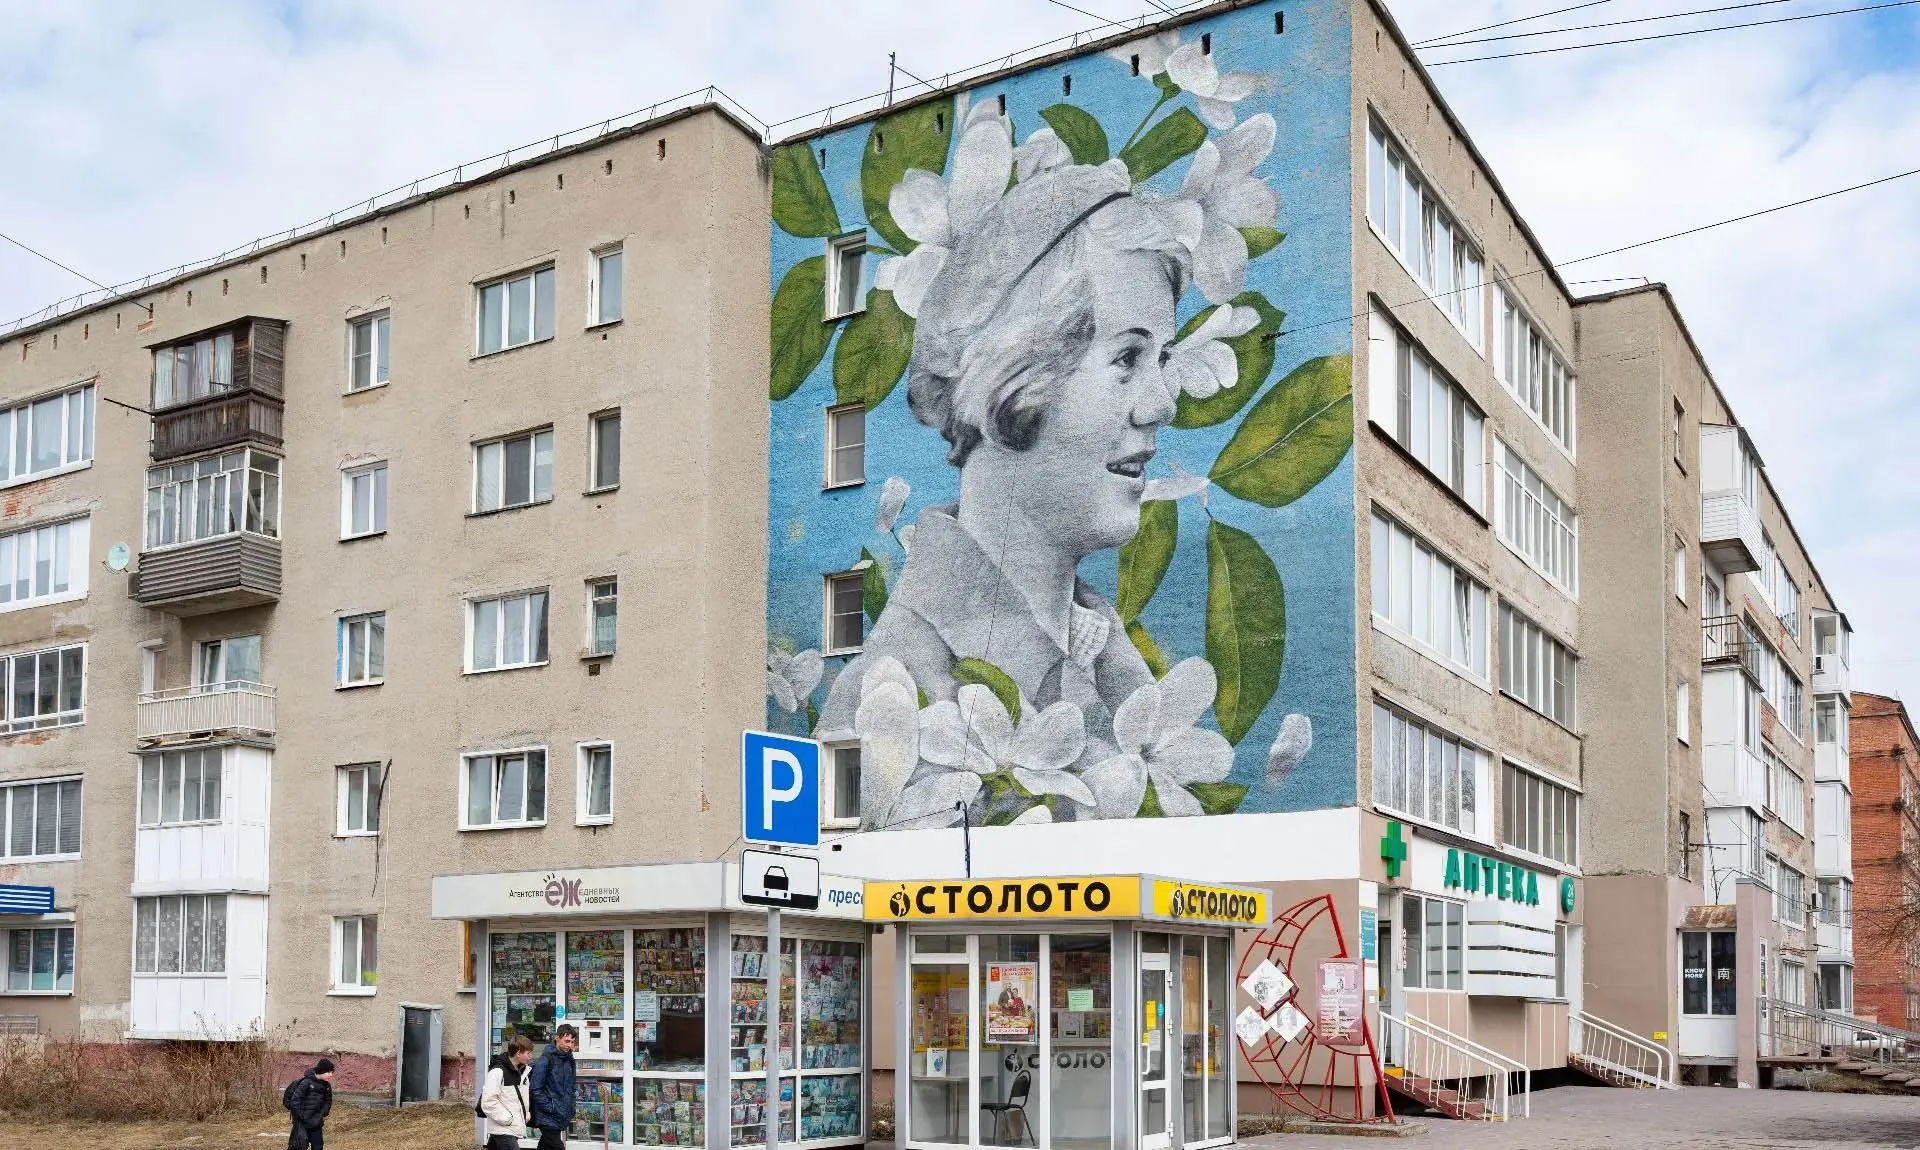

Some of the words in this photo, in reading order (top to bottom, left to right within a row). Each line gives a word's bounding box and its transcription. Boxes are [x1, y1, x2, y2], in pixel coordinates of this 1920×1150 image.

[763, 746, 803, 830] P
[1443, 848, 1540, 907] АПТЕКА
[915, 881, 1111, 914] СТОЛОТО
[1187, 888, 1257, 920] СТОЛОТО
[1717, 967, 1730, 980] 南
